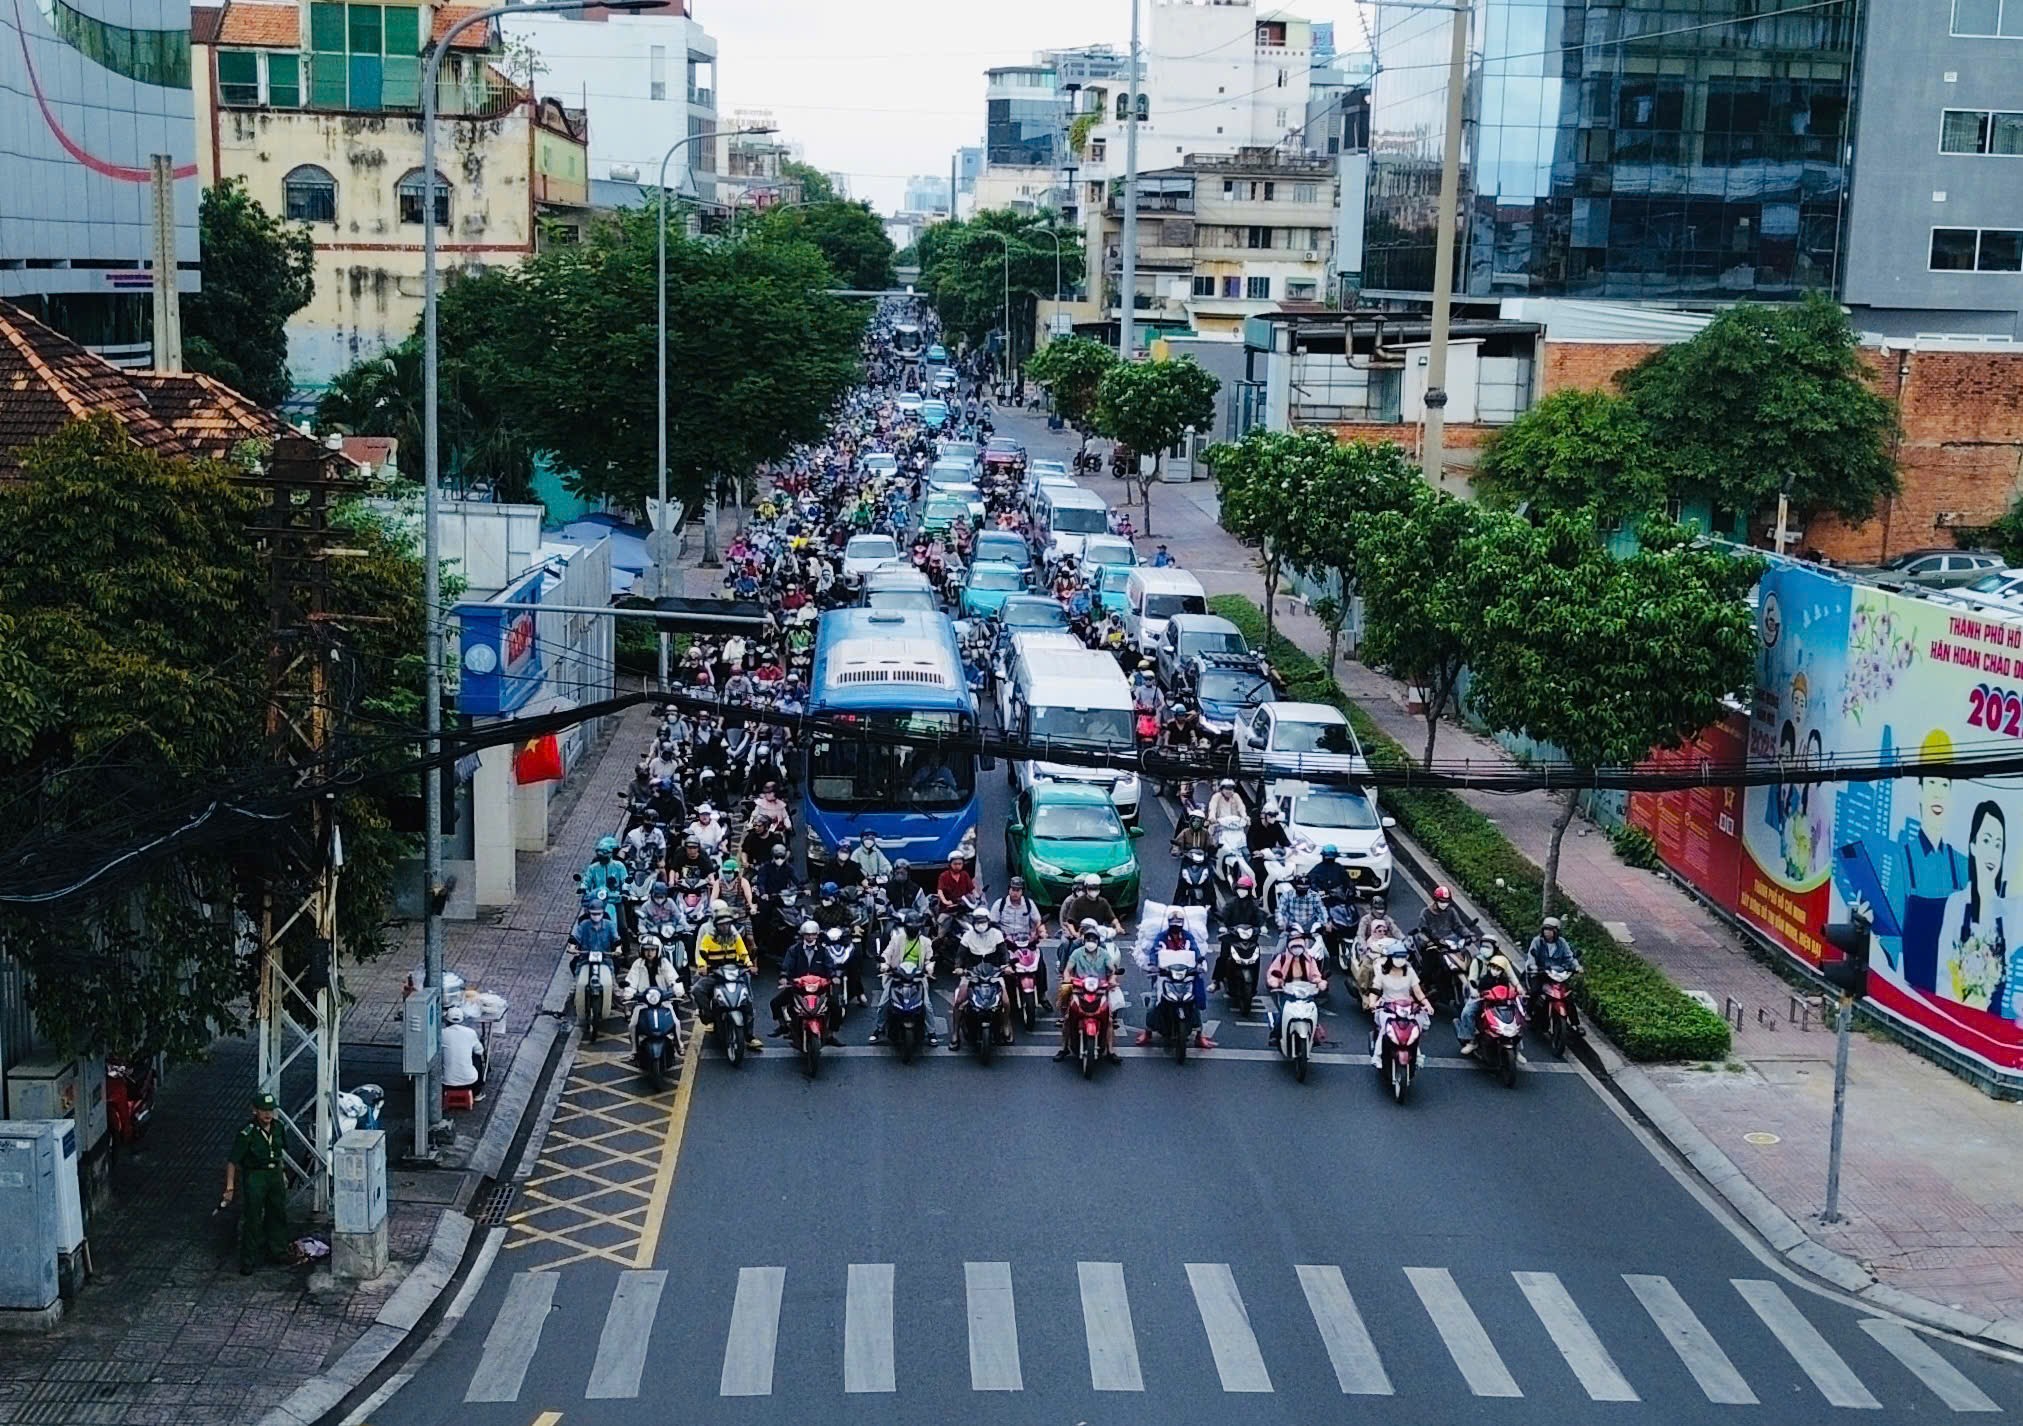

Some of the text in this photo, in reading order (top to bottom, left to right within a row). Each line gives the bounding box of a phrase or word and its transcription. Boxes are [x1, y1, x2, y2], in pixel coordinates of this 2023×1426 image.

[1949, 616, 1981, 640] THÀNH
[1984, 622, 2005, 645] PHỐ
[1930, 640, 1951, 662] HÂN
[1953, 645, 1981, 669] HOAN
[1983, 652, 2011, 676] CHÀO
[1967, 685, 2023, 738] 202
